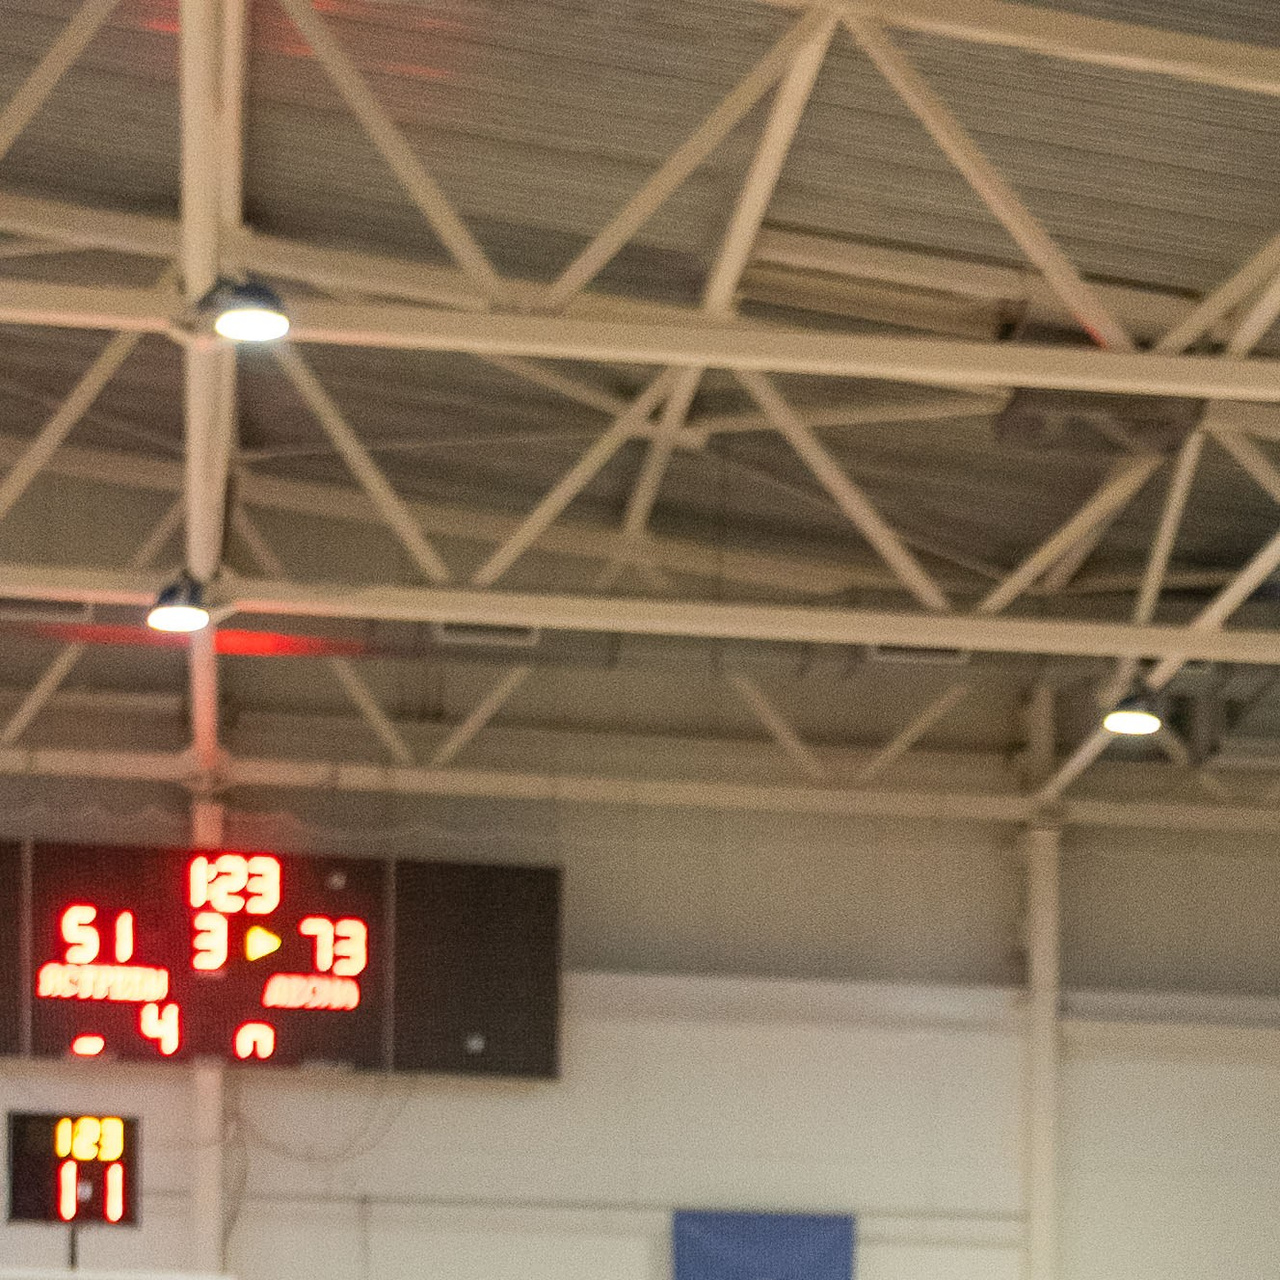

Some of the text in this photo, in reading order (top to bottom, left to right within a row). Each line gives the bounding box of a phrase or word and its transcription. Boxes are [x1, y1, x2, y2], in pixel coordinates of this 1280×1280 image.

[61, 904, 134, 965] 51
[192, 911, 229, 971] 3
[300, 916, 368, 977] 73
[140, 1002, 180, 1055] 4
